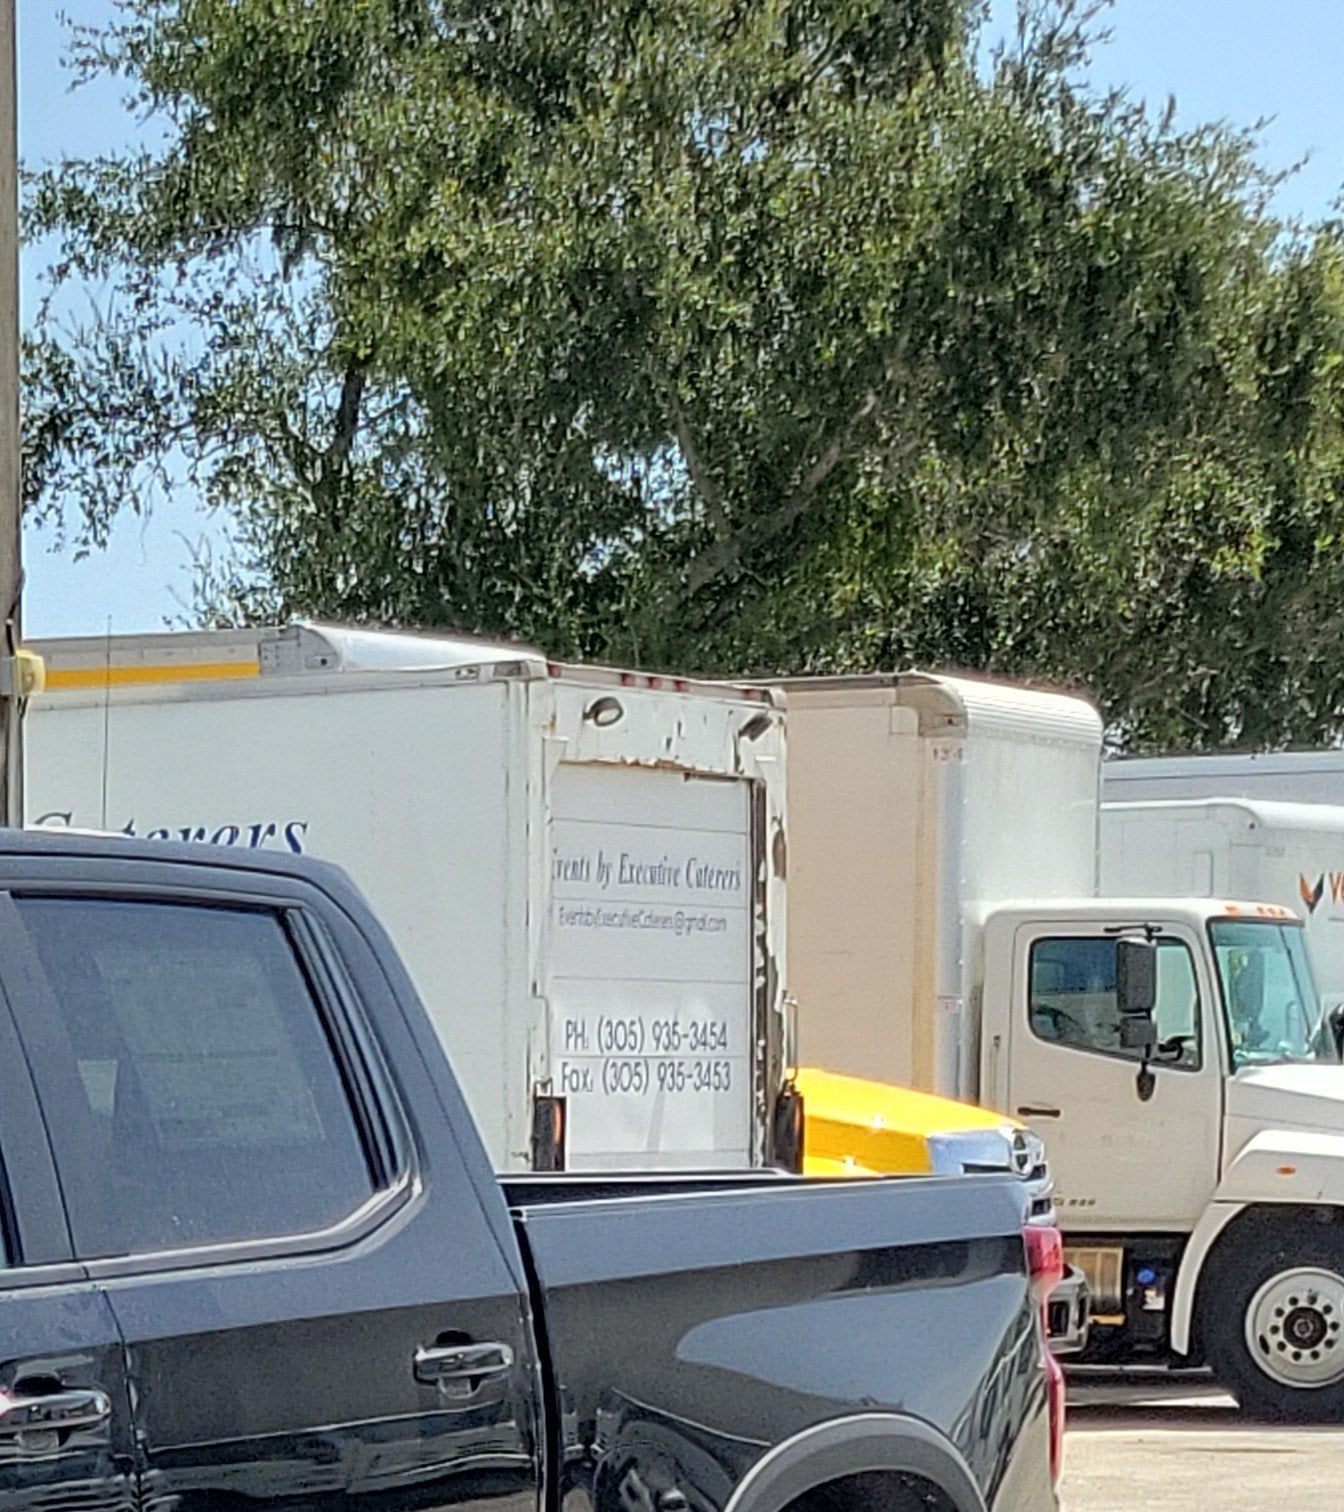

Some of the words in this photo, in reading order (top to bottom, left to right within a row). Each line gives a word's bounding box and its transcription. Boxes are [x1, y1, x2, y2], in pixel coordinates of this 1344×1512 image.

[551, 848, 590, 883] vents
[596, 850, 612, 890] by
[618, 852, 682, 888] Executive
[597, 1015, 645, 1054] (305)
[652, 1020, 728, 1051] 935-3454
[602, 1060, 650, 1096] (305)
[657, 1061, 731, 1092] 935-3453
